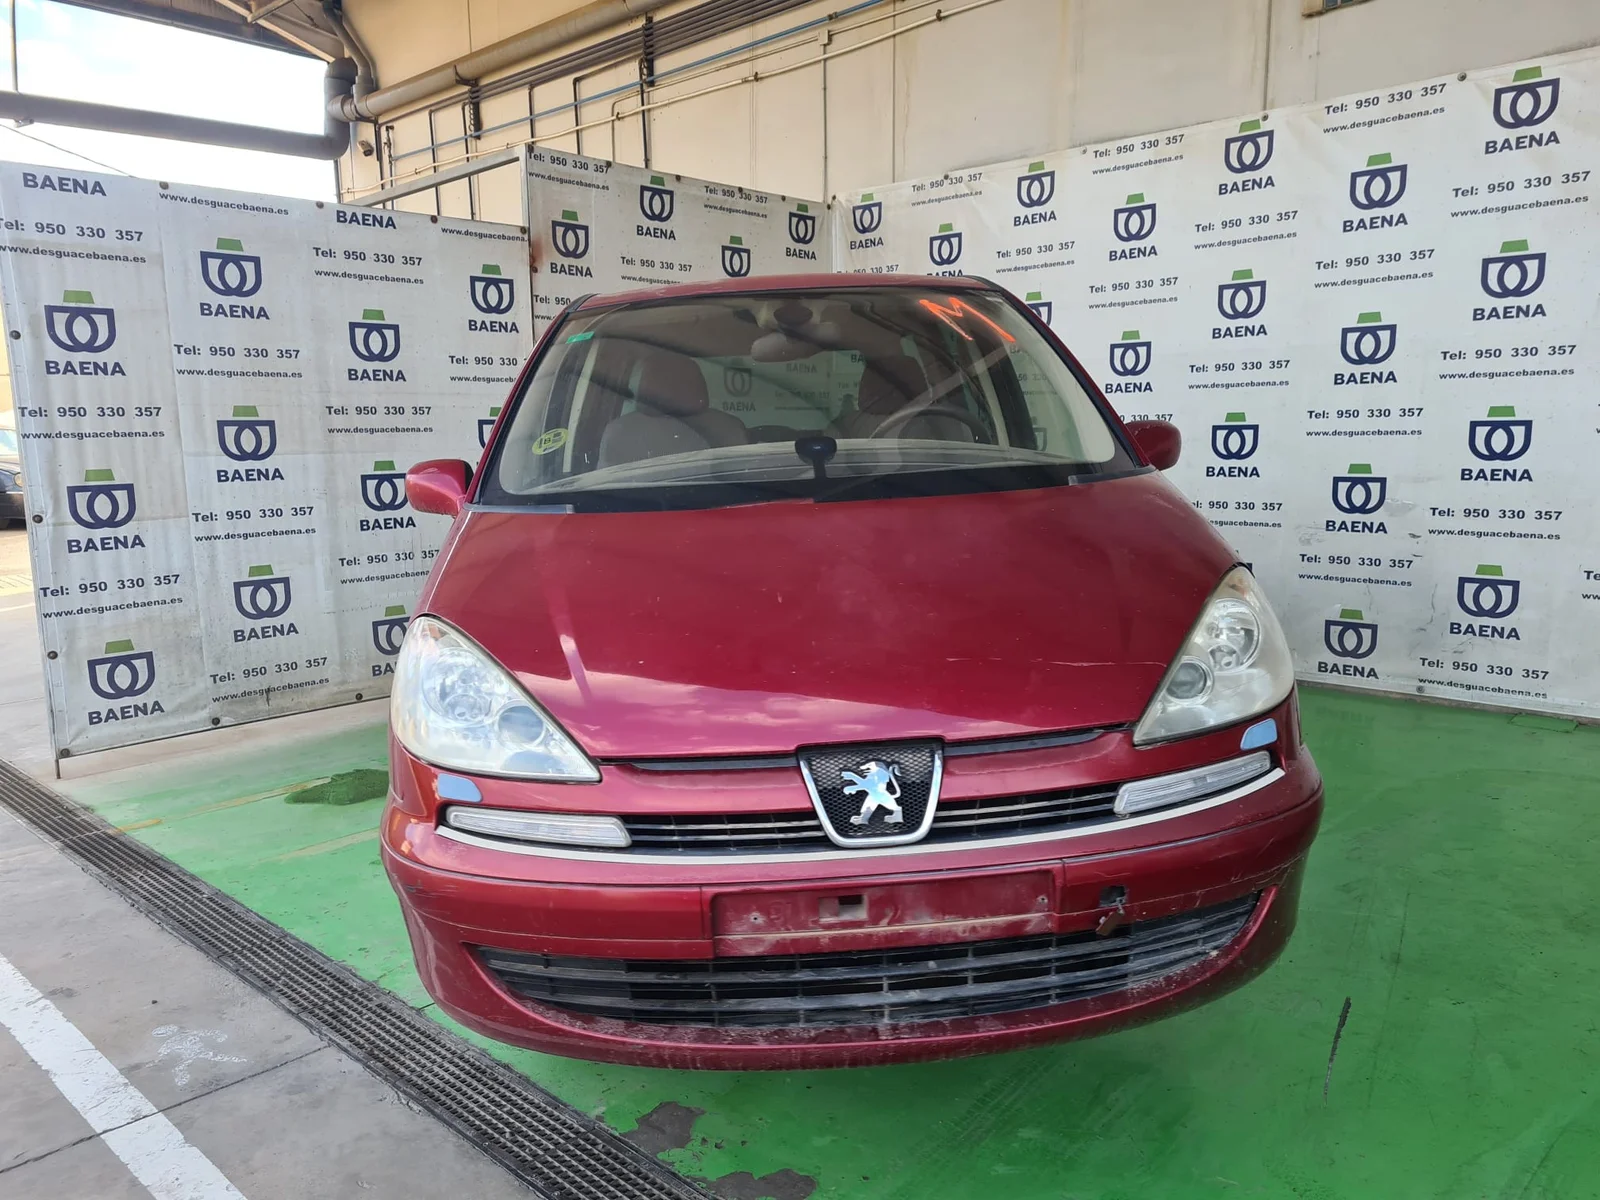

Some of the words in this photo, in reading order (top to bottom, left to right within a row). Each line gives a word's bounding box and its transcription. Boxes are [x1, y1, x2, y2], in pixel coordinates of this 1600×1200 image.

[1325, 104, 1348, 116] Tel:
[1355, 96, 1380, 109] 950
[1387, 90, 1412, 103] 330
[1421, 83, 1447, 97] 357
[1323, 106, 1445, 134] www.desguacebaena.es
[1093, 148, 1111, 159] Tel:
[1116, 144, 1134, 155] 950
[1140, 139, 1159, 150] 330
[1165, 134, 1184, 145] 357
[1485, 131, 1560, 155] BAENA
[528, 151, 544, 162] Tel:
[550, 156, 567, 167] 950
[572, 160, 588, 170] 330
[594, 162, 610, 174] 357
[1092, 154, 1183, 175] www.desguacebaena.es
[23, 172, 106, 196] BAENA
[528, 171, 609, 191] www.desguacebaena.es
[912, 184, 926, 193] Tel:
[930, 180, 944, 189] 950
[949, 176, 963, 185] 330
[968, 173, 982, 182] 357
[1219, 176, 1275, 195] BAENA
[1453, 187, 1478, 198] Tel:
[1487, 181, 1514, 194] 950
[1524, 176, 1552, 189] 330
[1561, 171, 1591, 184] 357
[705, 186, 718, 196] Tel:
[722, 189, 735, 199] 950
[739, 191, 752, 201] 330
[755, 194, 768, 203] 357
[159, 192, 289, 216] www.desguacebaena.es
[1451, 195, 1588, 218] www.desguacebaena.es
[337, 210, 396, 229] BAENA
[1014, 210, 1056, 226] BAENA
[1342, 213, 1408, 233] BAENA
[35, 222, 66, 235] 950
[76, 226, 105, 238] 330
[116, 229, 143, 241] 357
[441, 227, 528, 242] www.desguacebaena.
[637, 225, 676, 241] BAENA
[850, 237, 884, 250] BAENA
[996, 250, 1011, 259] Tel:
[1016, 247, 1032, 256] 950
[1037, 244, 1053, 253] 330
[1059, 241, 1075, 250] 357
[313, 247, 336, 258] Tel:
[344, 250, 366, 261] 950
[373, 253, 395, 264] 330
[402, 255, 422, 266] 357
[786, 247, 816, 260] BAENA
[1109, 246, 1158, 261] BAENA
[1316, 260, 1338, 270] Tel:
[1346, 256, 1369, 268] 950
[1377, 253, 1401, 264] 330
[1410, 249, 1435, 260] 357
[550, 262, 592, 278] BAENA
[621, 257, 636, 266] Tel:
[640, 259, 655, 268] 950
[660, 261, 674, 270] 330
[678, 263, 692, 272] 357
[996, 259, 1074, 274] www.desguacebaena.es
[315, 270, 424, 284] www.desguacebaena.es
[1314, 271, 1433, 289] www.desguacebaena.es
[1089, 285, 1106, 294] Tel:
[1112, 282, 1129, 291] 950
[1135, 280, 1154, 288] 330
[1160, 277, 1178, 286] 357
[1089, 296, 1178, 309] www.desguacebaena.es
[200, 302, 270, 320] BAENA
[1473, 304, 1546, 321] BAENA
[469, 320, 519, 333] BAENA
[1212, 325, 1267, 339] BAENA
[174, 344, 201, 355] Tel:
[209, 346, 235, 357] 950
[244, 347, 269, 358] 330
[277, 348, 300, 359] 357
[1441, 351, 1466, 360] Tel:
[1475, 349, 1502, 359] 950
[1511, 347, 1538, 357] 330
[1548, 345, 1576, 355] 357
[45, 360, 126, 376] BAENA
[449, 355, 468, 364] Tel:
[475, 357, 493, 366] 950
[500, 357, 517, 366] 330
[1189, 365, 1208, 373] Tel:
[1215, 363, 1234, 372] 950
[1242, 361, 1262, 370] 330
[1269, 360, 1290, 369] 357
[176, 367, 302, 378] www.desguacebaena.es
[348, 369, 406, 382] BAENA
[1334, 371, 1397, 385] BAENA
[1439, 368, 1574, 380] www.desguacebaena.es
[1105, 382, 1153, 394] BAENA
[1188, 379, 1289, 390] www.desguacebaena.es
[18, 407, 48, 418] Tel:
[57, 406, 87, 417] 950
[97, 406, 125, 417] 330
[135, 406, 162, 417] 357
[1307, 410, 1329, 419] Tel:
[1336, 410, 1360, 418] 950
[1367, 408, 1391, 418] 330
[1399, 408, 1423, 417] 357
[21, 430, 164, 440] www.desguacebaena.es
[1306, 428, 1422, 437] www.desguacebaena.es
[217, 468, 284, 482] BAENA
[1206, 466, 1260, 478] BAENA
[1460, 468, 1533, 482] BAENA
[193, 511, 218, 522] Tel:
[226, 509, 251, 521] 950
[260, 508, 283, 518] 330
[291, 506, 314, 517] 357
[1208, 501, 1228, 510] 950
[1235, 502, 1255, 510] 330
[1262, 502, 1283, 511] 357
[1430, 508, 1455, 517] Tel:
[1463, 509, 1489, 518] 950
[1498, 510, 1525, 519] 330
[1534, 511, 1562, 520] 357
[360, 517, 416, 531] BAENA
[1326, 520, 1387, 534] BAENA
[195, 526, 316, 542] www.desguacebaena.es
[1428, 528, 1560, 540] www.desguacebaena.es
[67, 535, 145, 553] BAENA
[339, 557, 360, 567] Tel:
[367, 554, 388, 564] 950
[395, 552, 415, 562] 330
[340, 570, 430, 584] www.desguacebaena
[41, 586, 69, 598] Tel:
[79, 581, 107, 594] 950
[117, 578, 144, 590] 330
[154, 574, 180, 586] 357
[43, 596, 182, 618] www.desguacebaena.es
[233, 622, 299, 642] BAENA
[1450, 622, 1520, 640] BAENA
[210, 672, 235, 684] Tel:
[243, 666, 267, 679] 950
[275, 661, 298, 673] 330
[306, 657, 328, 670] 357
[1318, 661, 1379, 680] BAENA
[1420, 658, 1444, 669] Tel:
[1452, 660, 1478, 672] 950
[1486, 664, 1513, 676] 330
[1522, 668, 1549, 680] 357
[212, 677, 329, 702] www.desguacebaena.es
[1418, 677, 1548, 699] www.desguacebaena.es
[88, 700, 164, 725] BAENA
